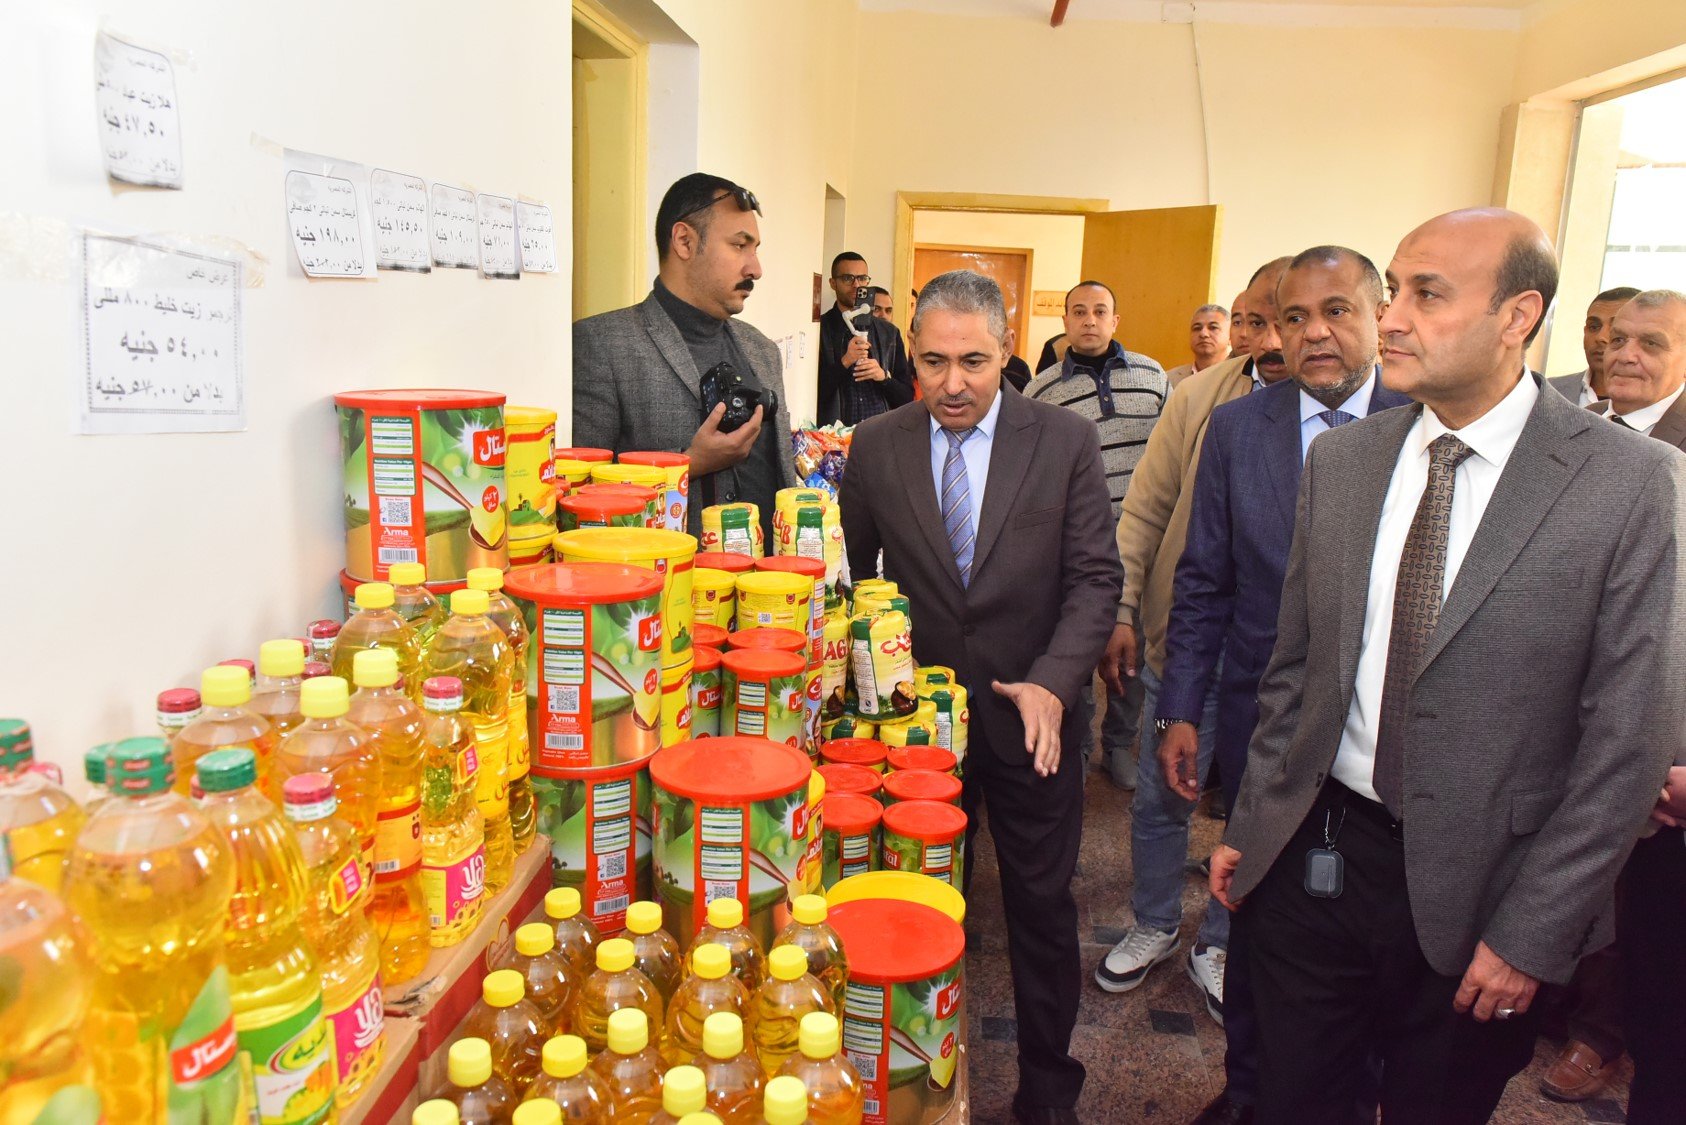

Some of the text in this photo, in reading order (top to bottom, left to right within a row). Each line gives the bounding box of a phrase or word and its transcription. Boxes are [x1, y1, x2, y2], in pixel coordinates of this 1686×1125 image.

[296, 225, 317, 247] جنيه
[154, 293, 178, 315] خليط
[181, 302, 202, 320] زيت
[120, 329, 159, 363] جنيه
[95, 375, 126, 401] جنيه
[384, 526, 409, 536] Arma
[551, 714, 576, 723] Arma
[600, 879, 624, 889] Arma
